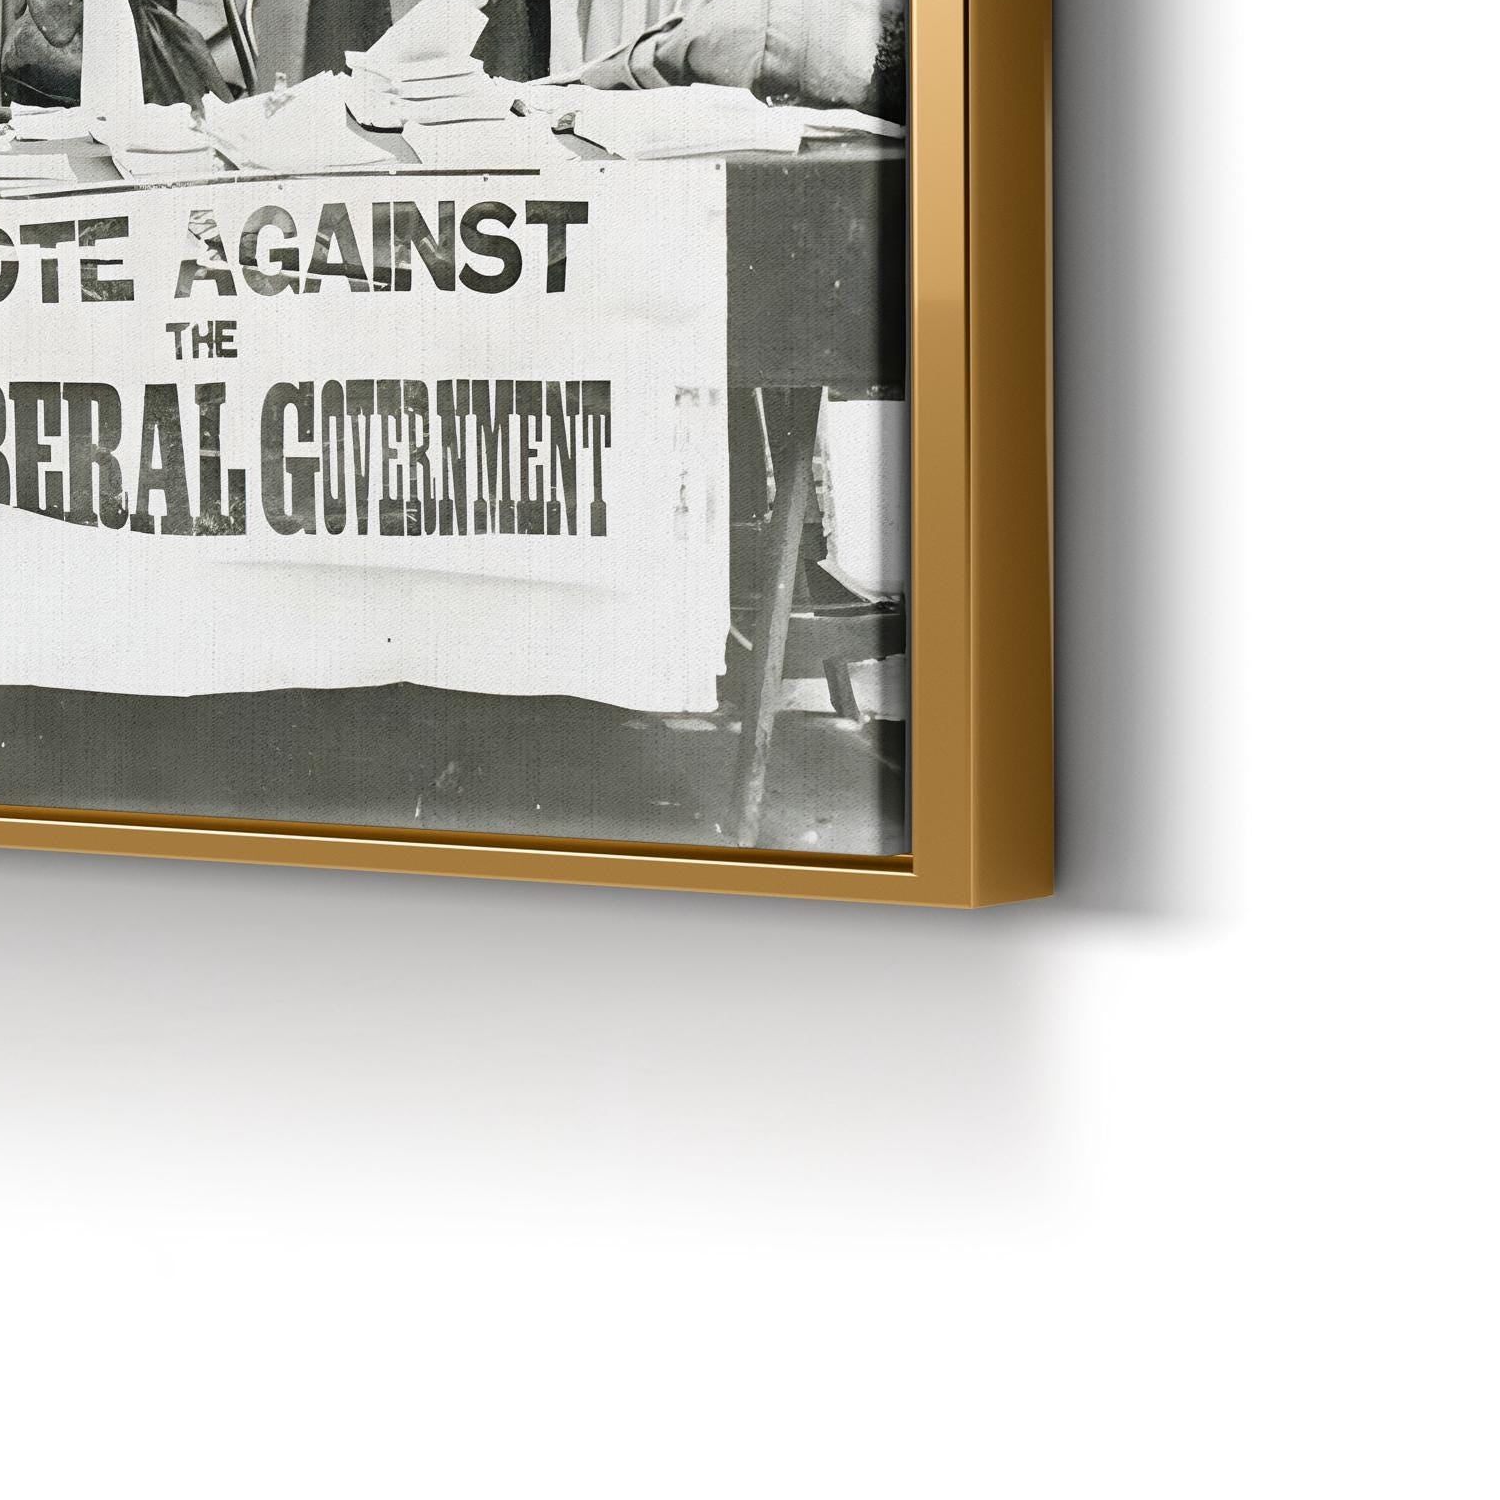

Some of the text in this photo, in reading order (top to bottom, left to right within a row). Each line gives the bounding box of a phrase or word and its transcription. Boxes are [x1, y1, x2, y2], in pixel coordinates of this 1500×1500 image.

[173, 200, 589, 299] AGAINST
[165, 320, 238, 360] THE
[260, 379, 612, 537] GOVERNMENT
